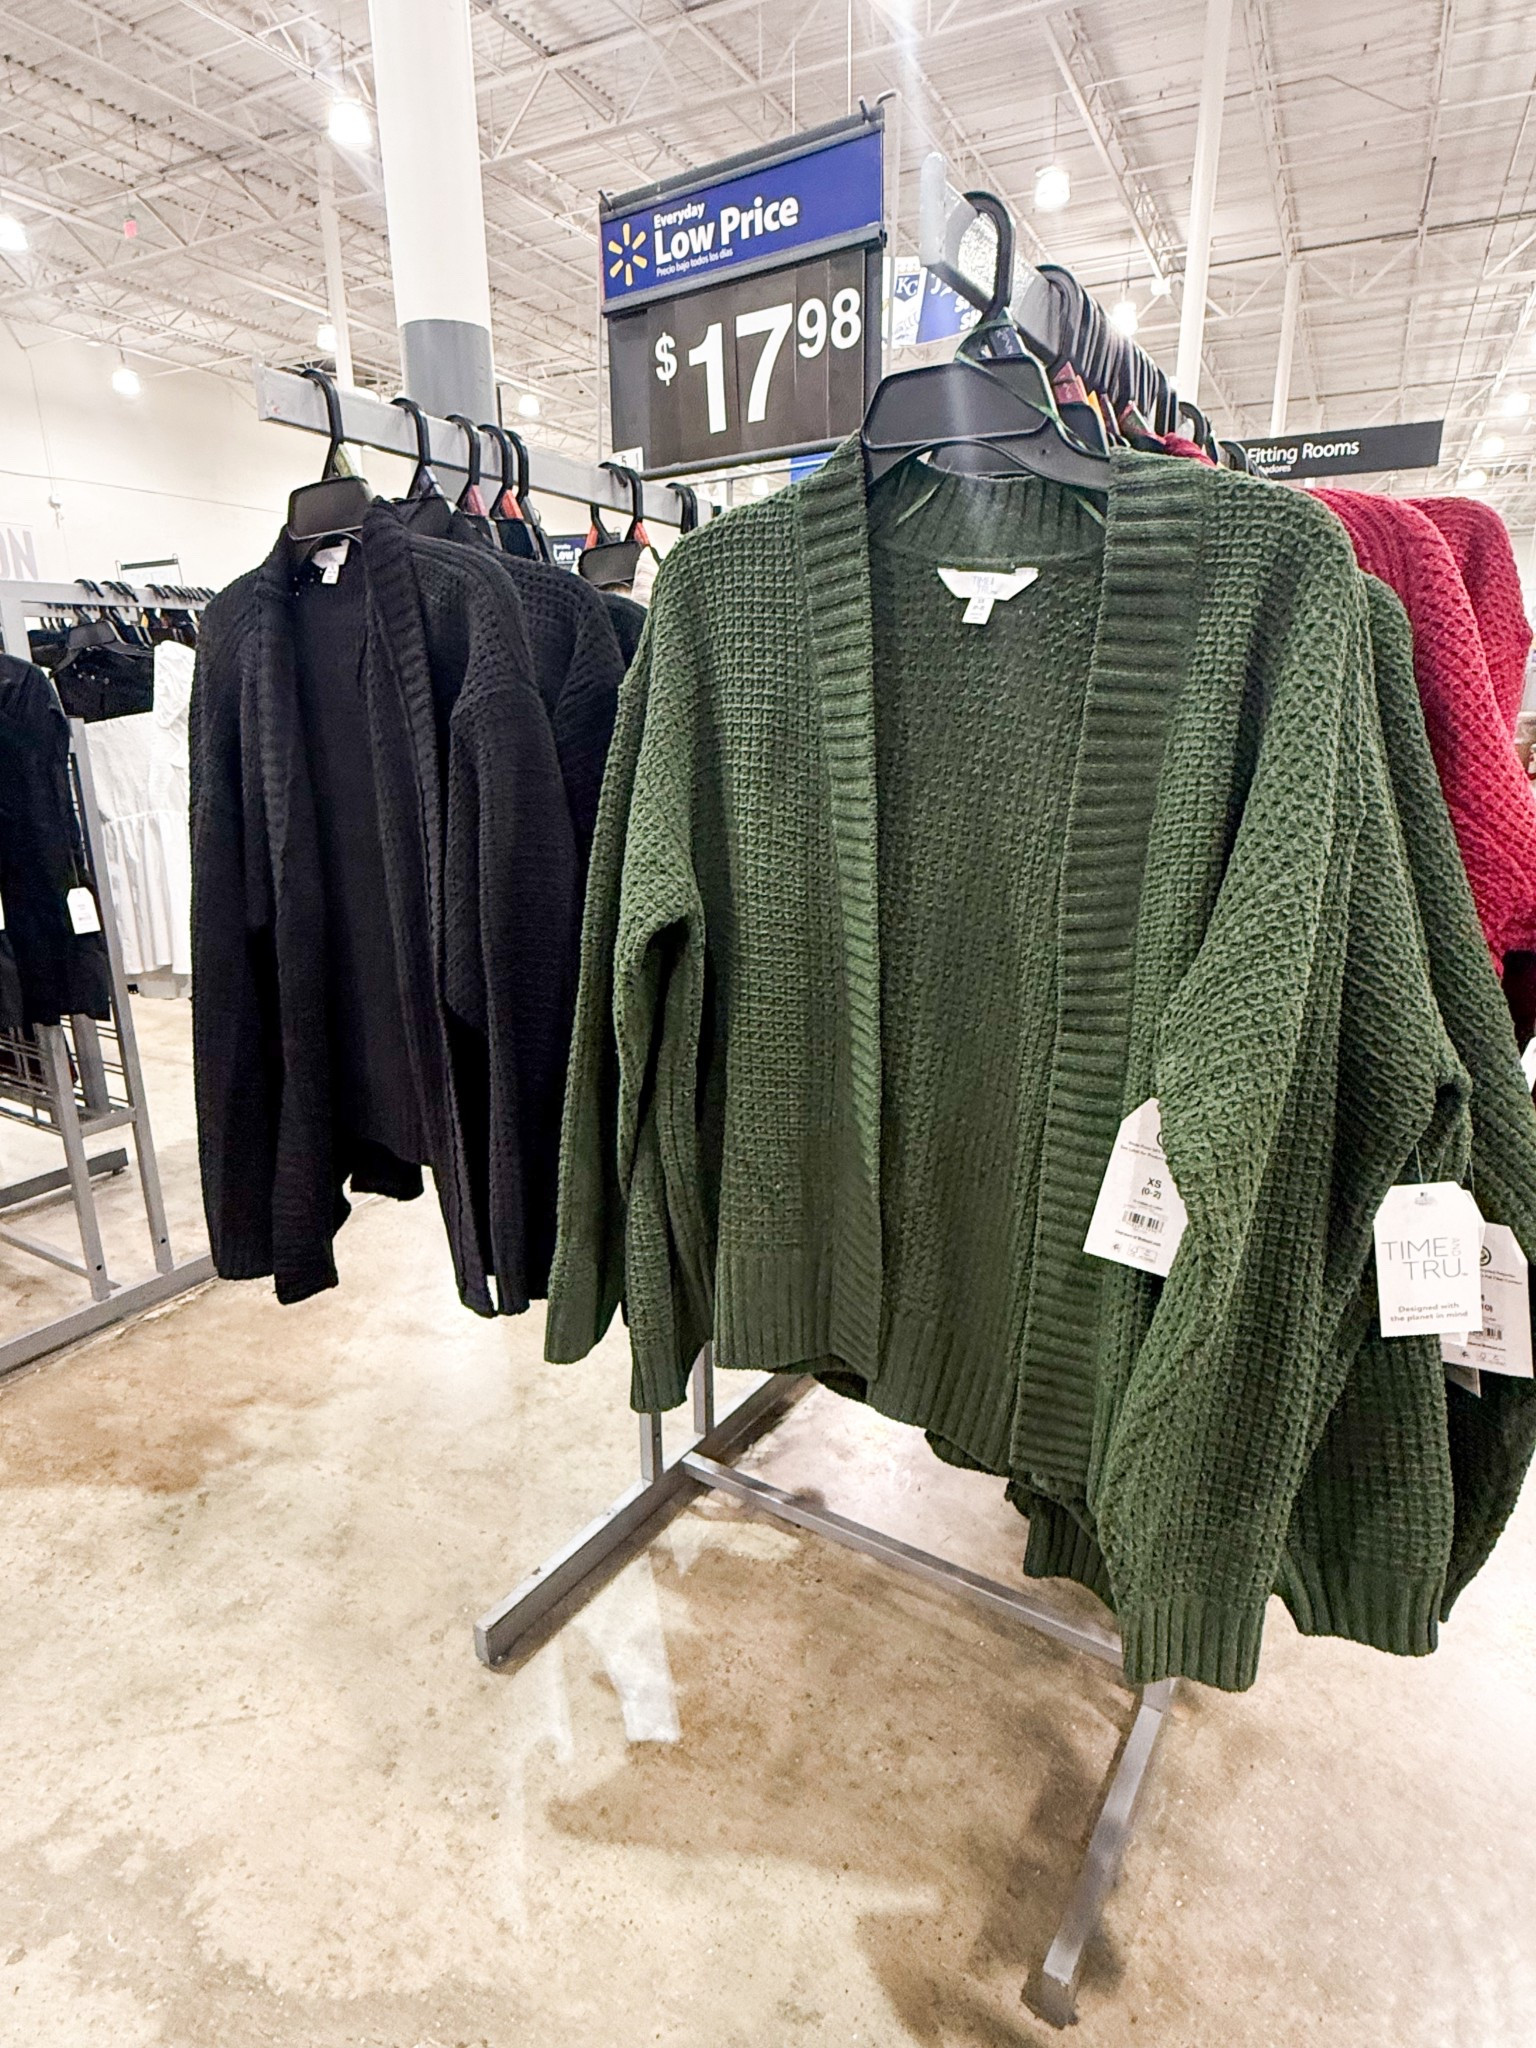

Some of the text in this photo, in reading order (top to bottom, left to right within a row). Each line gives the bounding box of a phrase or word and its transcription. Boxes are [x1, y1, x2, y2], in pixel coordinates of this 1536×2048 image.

[654, 203, 705, 229] Everyday
[654, 196, 799, 265] Low Price
[656, 264, 676, 277] Precio
[676, 260, 690, 273] bajo
[690, 254, 709, 267] todos
[709, 252, 719, 262] los
[896, 277, 918, 296] KC
[1248, 440, 1359, 464] Fitting Rooms
[1141, 1187, 1162, 1200] (0-2)
[1147, 1177, 1162, 1189] XS
[1381, 1237, 1449, 1261] TIME
[1402, 1258, 1462, 1280] TRU
[1398, 1302, 1459, 1313] Designed with
[1407, 1314, 1433, 1322] planet
[1446, 1310, 1469, 1318] mind
